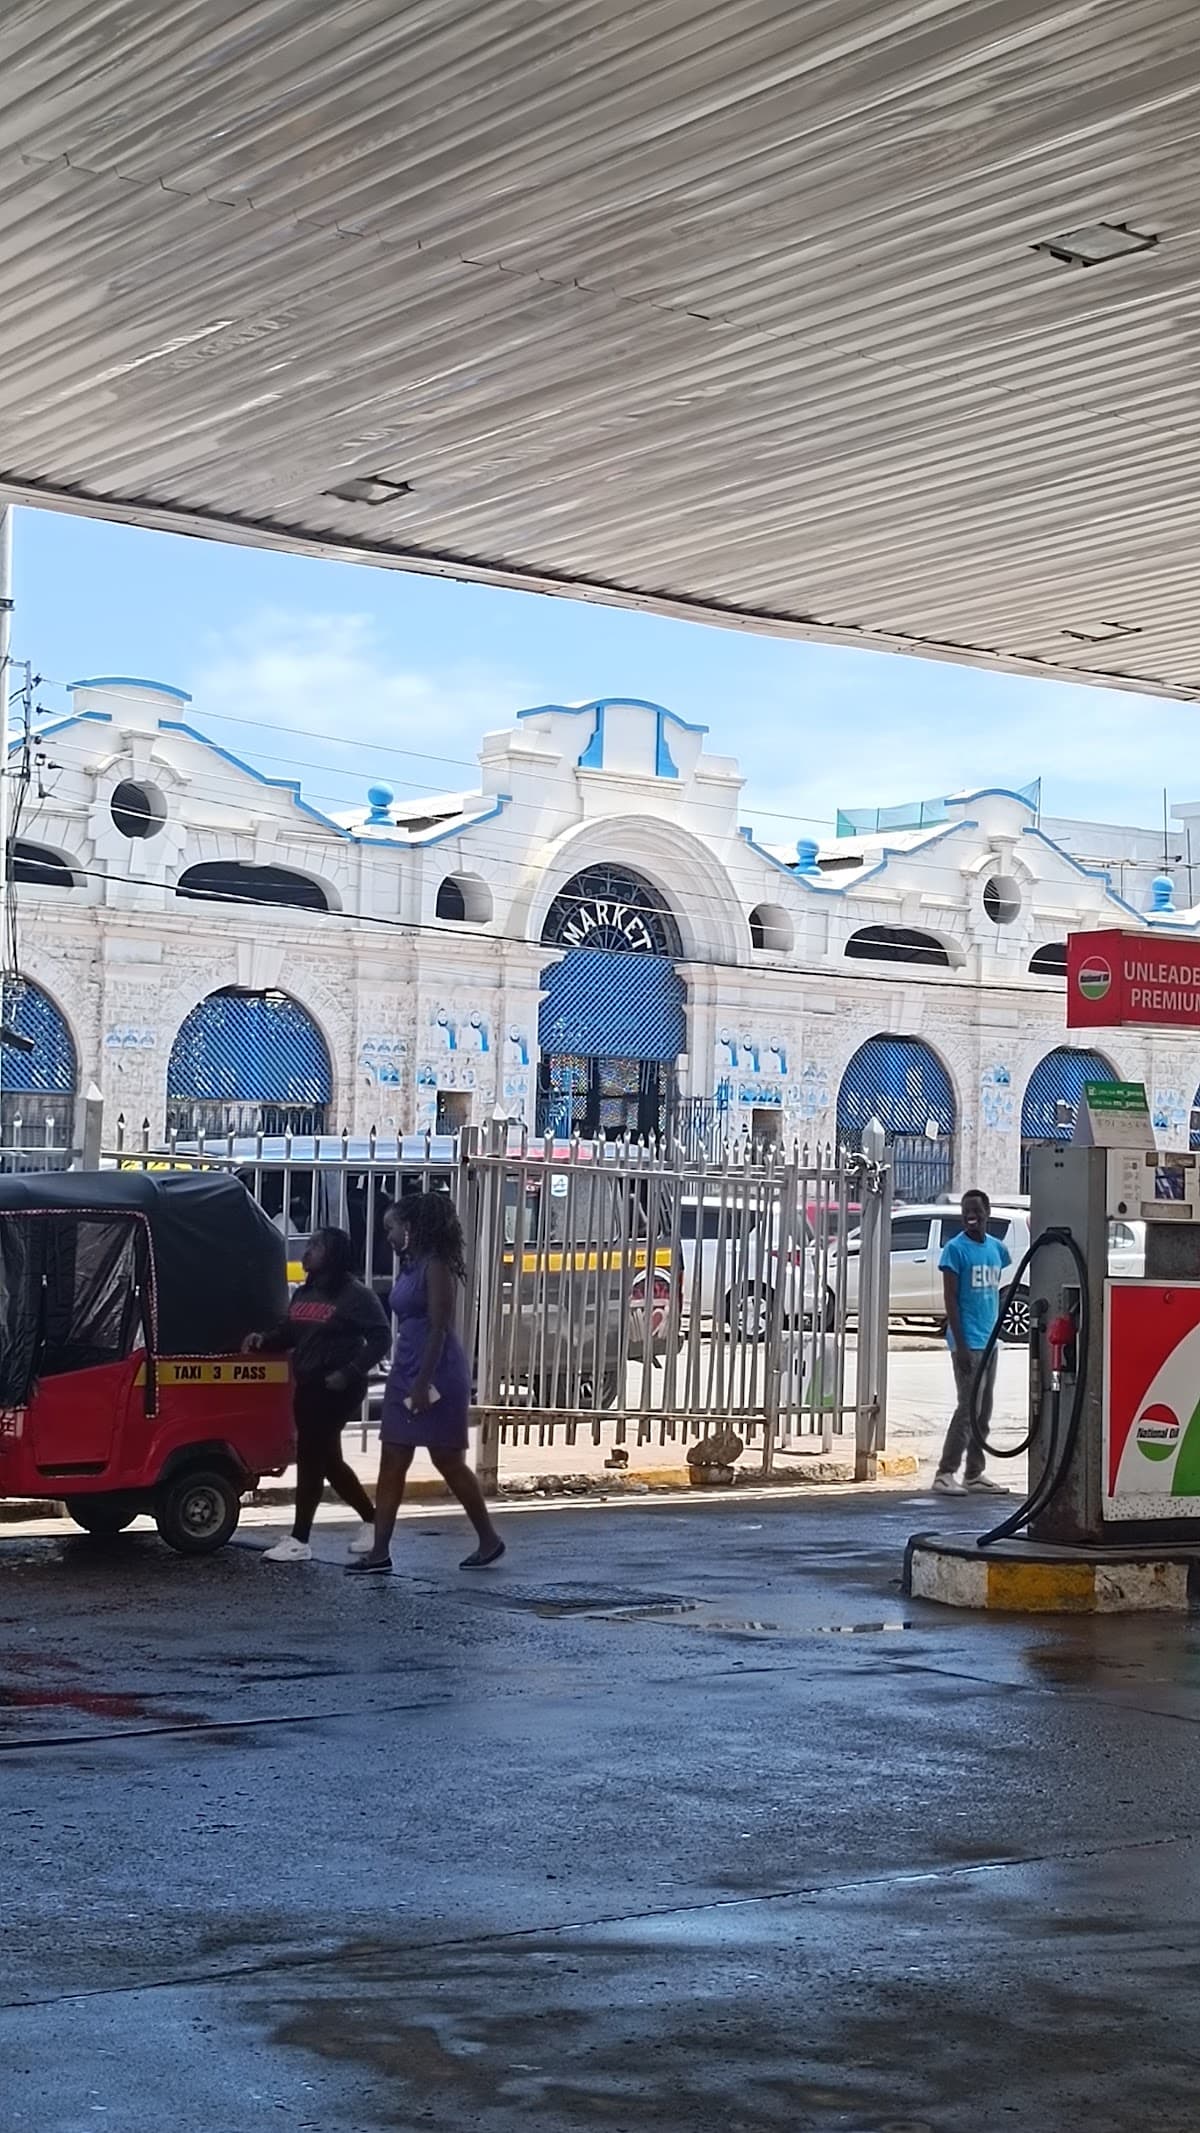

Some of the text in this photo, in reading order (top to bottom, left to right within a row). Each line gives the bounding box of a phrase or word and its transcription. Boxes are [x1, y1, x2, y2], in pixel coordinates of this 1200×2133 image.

[562, 901, 652, 949] MARKET
[174, 1365, 267, 1380] TAXI 3 PASS
